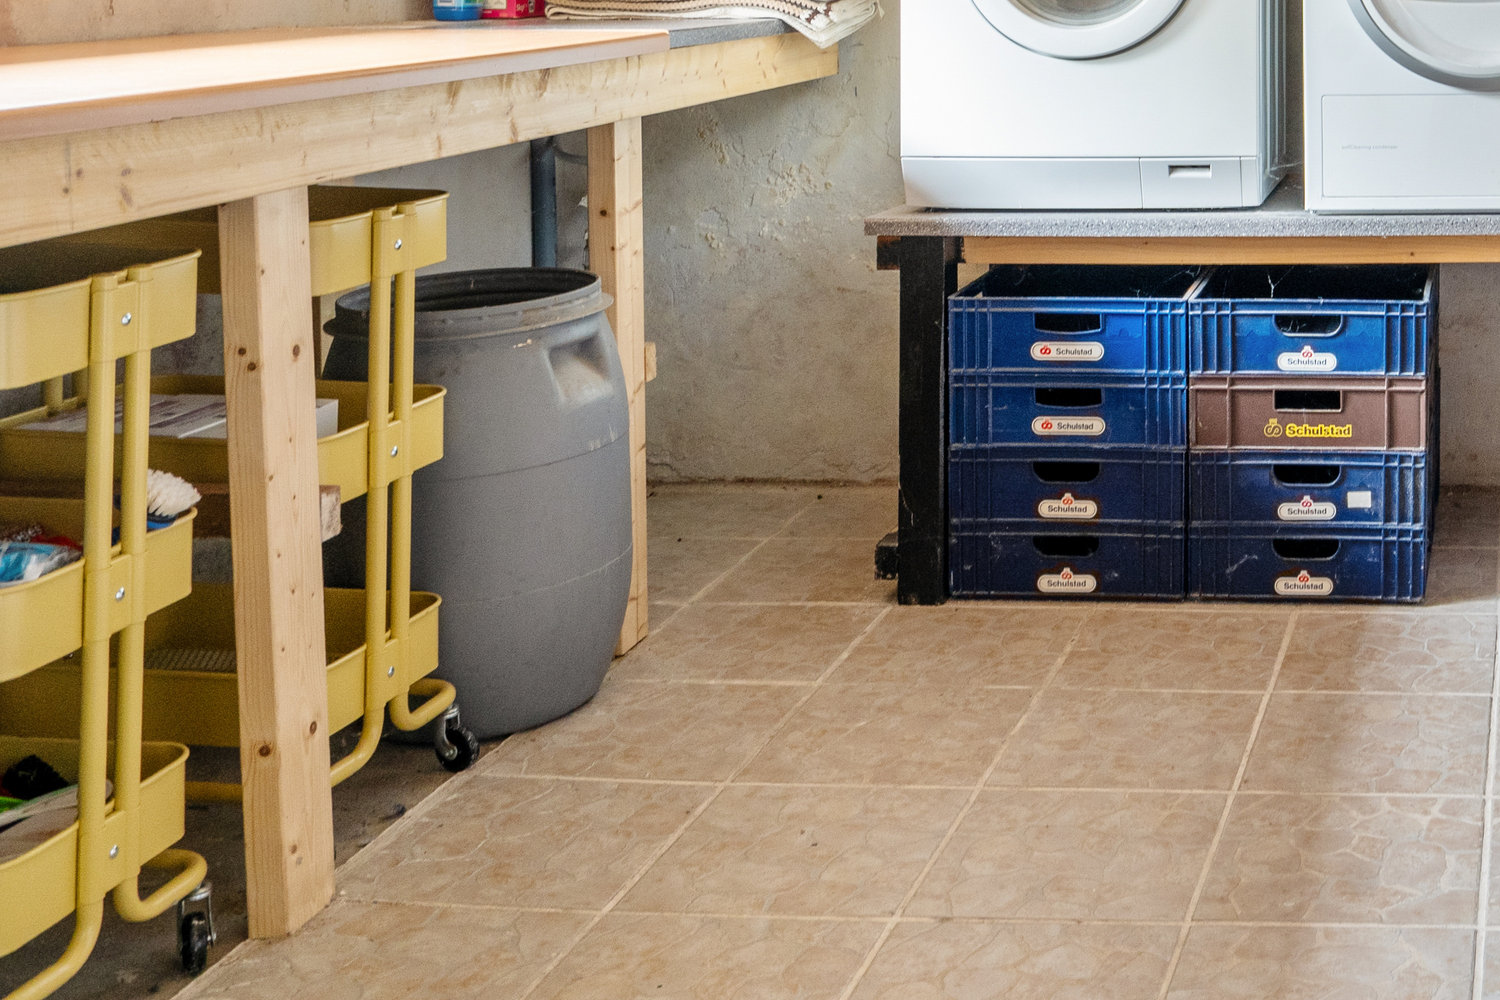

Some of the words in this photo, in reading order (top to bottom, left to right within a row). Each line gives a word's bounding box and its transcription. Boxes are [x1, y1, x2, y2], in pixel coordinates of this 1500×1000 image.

[1055, 347, 1093, 356] Schulstad
[1287, 357, 1328, 366] Schulstad
[1056, 421, 1094, 431] Schulstad
[1285, 423, 1353, 439] Schulstad
[1047, 504, 1088, 514] Schulstad
[1287, 506, 1328, 516] Schulstad
[1046, 578, 1087, 589] Schulstad
[1284, 581, 1324, 591] Schulstad
